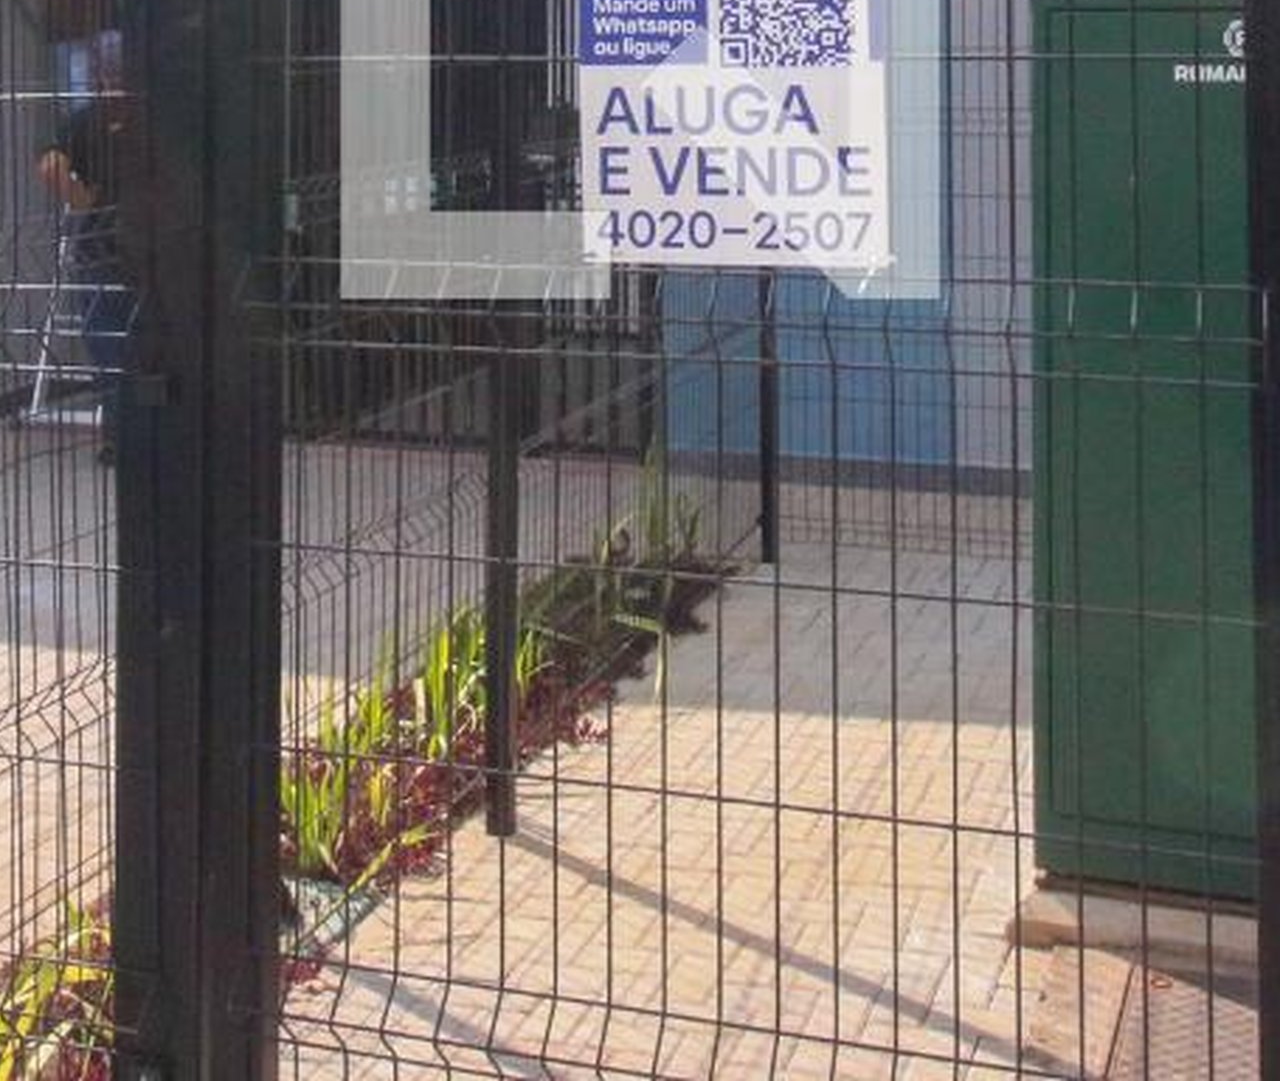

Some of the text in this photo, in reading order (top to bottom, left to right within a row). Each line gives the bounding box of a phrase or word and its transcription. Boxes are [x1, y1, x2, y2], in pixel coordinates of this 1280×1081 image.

[593, 17, 696, 38] Whatsapp
[594, 36, 671, 60] ou ligue
[596, 85, 820, 136] ALUGA
[600, 147, 874, 197] E VENDE
[597, 209, 873, 251] 4020-2507
